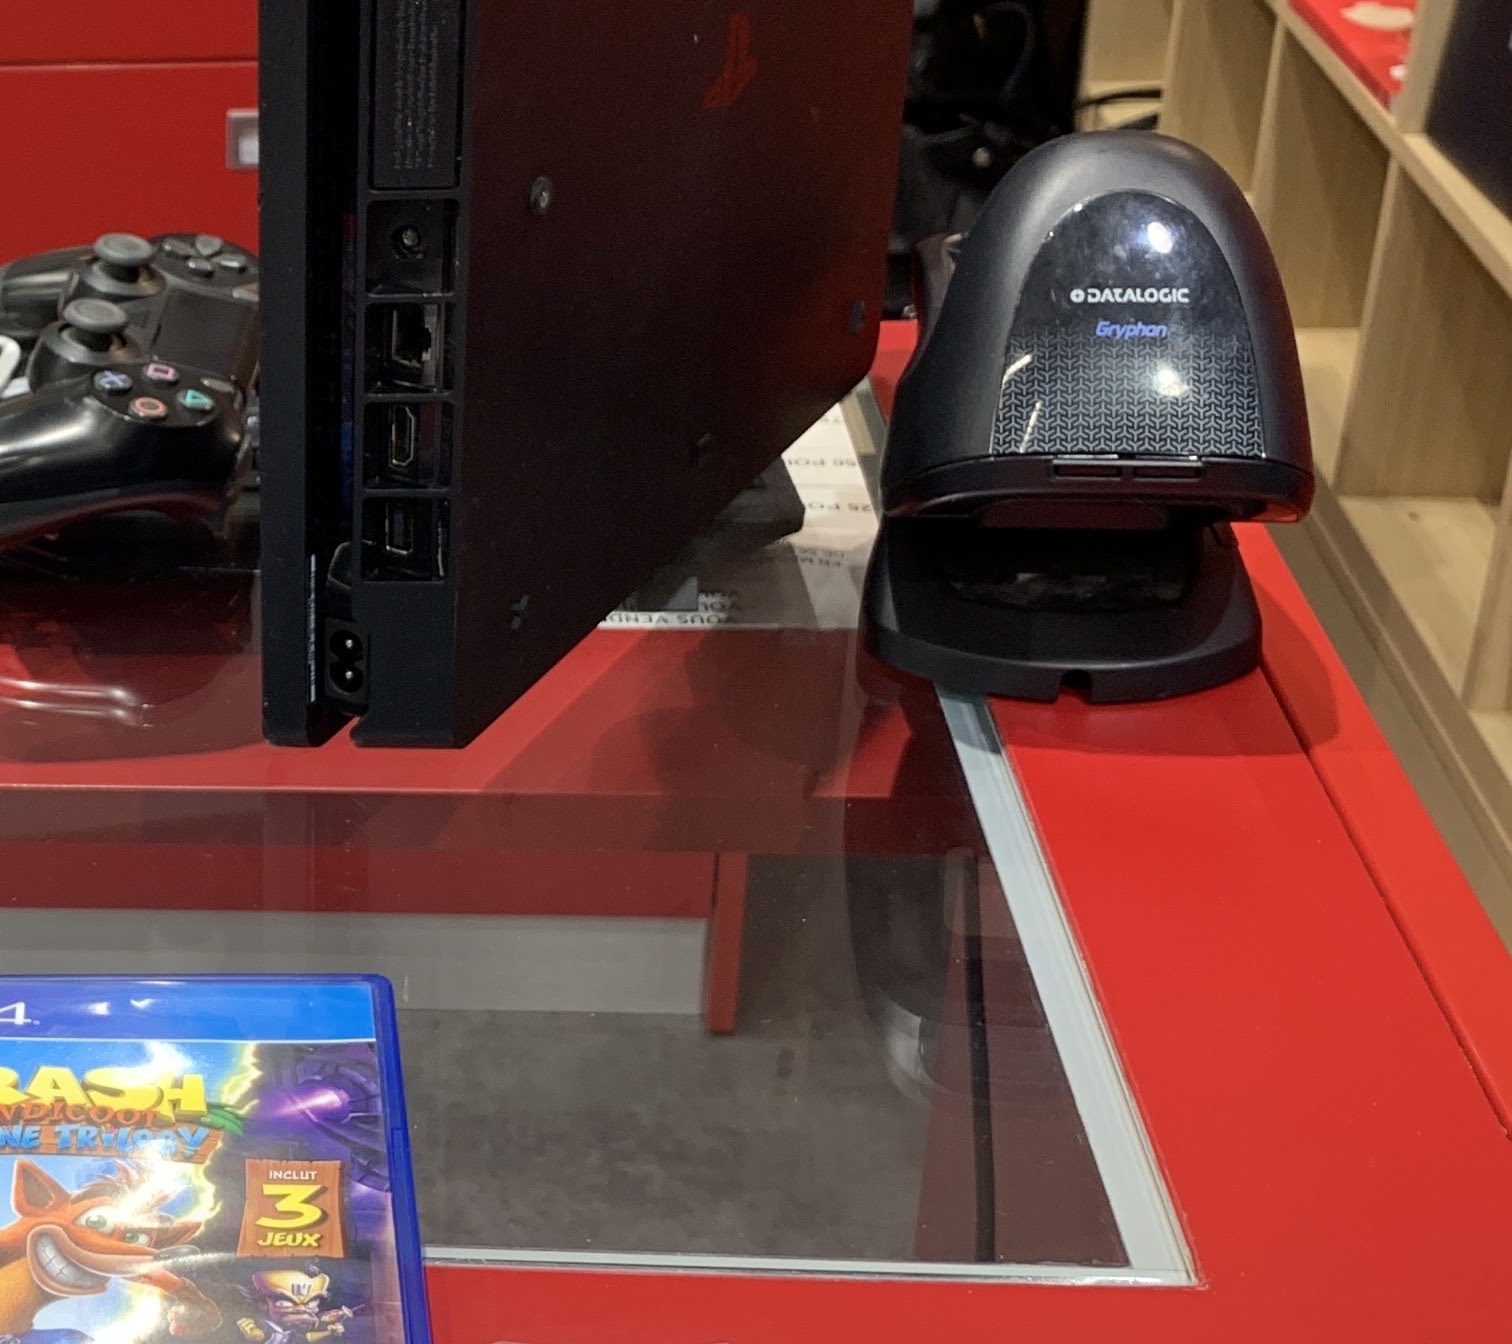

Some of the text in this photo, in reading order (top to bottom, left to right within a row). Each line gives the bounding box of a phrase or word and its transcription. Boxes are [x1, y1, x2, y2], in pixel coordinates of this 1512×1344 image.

[1087, 287, 1190, 303] DATALOGIC
[1096, 320, 1167, 340] Gryphon
[604, 611, 669, 624] VEND
[269, 1170, 317, 1180] INCLUT
[255, 1183, 325, 1229] 3
[257, 1231, 322, 1247] JEUX
